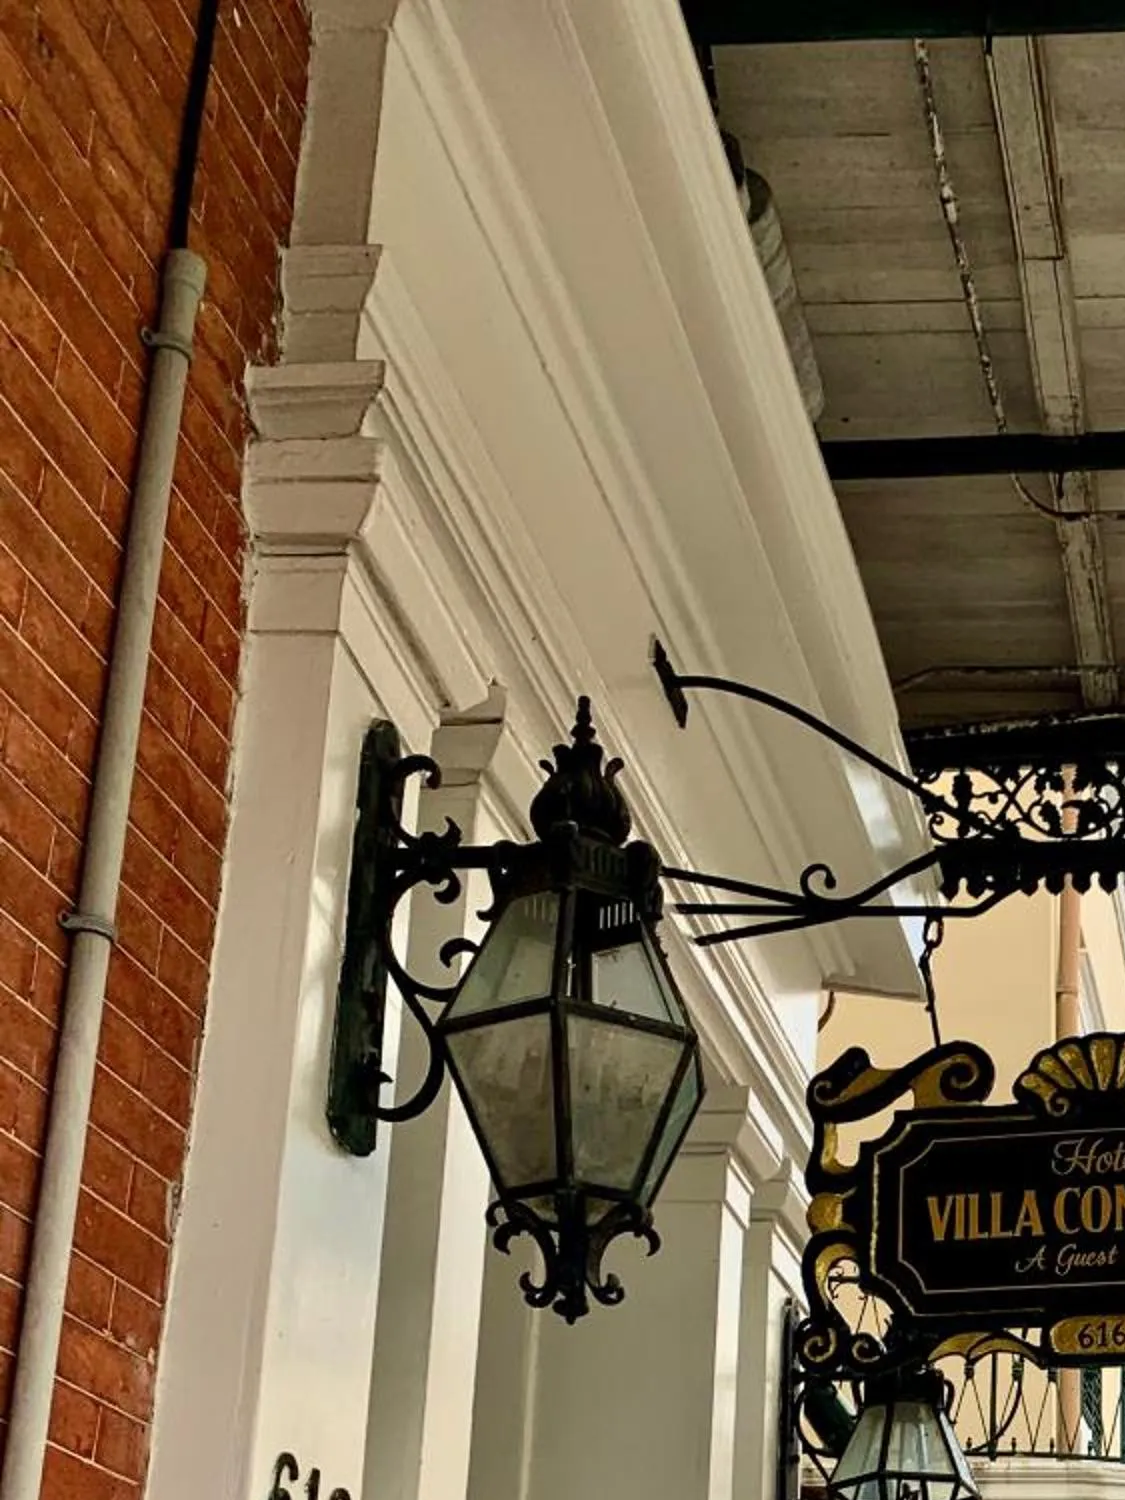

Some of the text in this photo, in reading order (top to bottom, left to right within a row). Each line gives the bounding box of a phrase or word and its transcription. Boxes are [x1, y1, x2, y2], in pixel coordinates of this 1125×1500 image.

[927, 1189, 1047, 1241] VILLA
[1015, 1245, 1047, 1273] A
[1055, 1243, 1117, 1275] Guest
